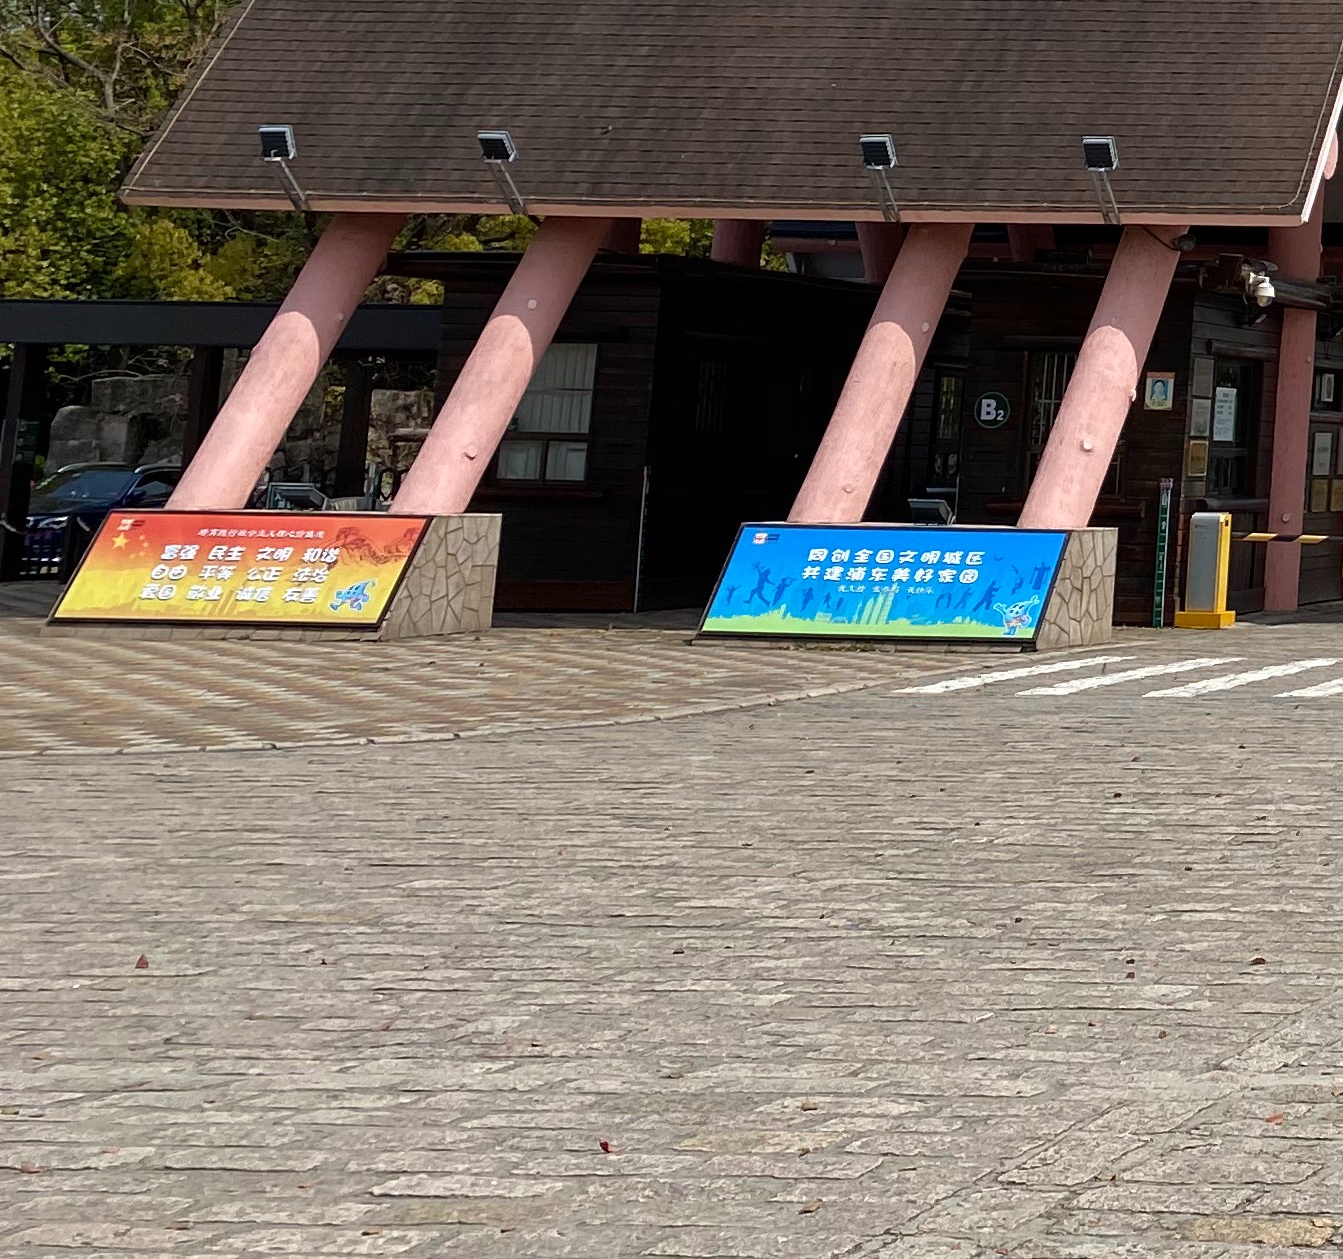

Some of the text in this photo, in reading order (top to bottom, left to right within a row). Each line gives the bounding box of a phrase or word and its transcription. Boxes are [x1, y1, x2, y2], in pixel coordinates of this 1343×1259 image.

[980, 398, 1005, 421] B2
[208, 545, 246, 562] 民主
[256, 546, 294, 562] 文明
[807, 547, 986, 566] 同创全国文明城区
[150, 564, 187, 581] 自由
[198, 565, 237, 581] 平等
[247, 566, 283, 582] 公正
[801, 565, 979, 584] 共建浦东美好家园
